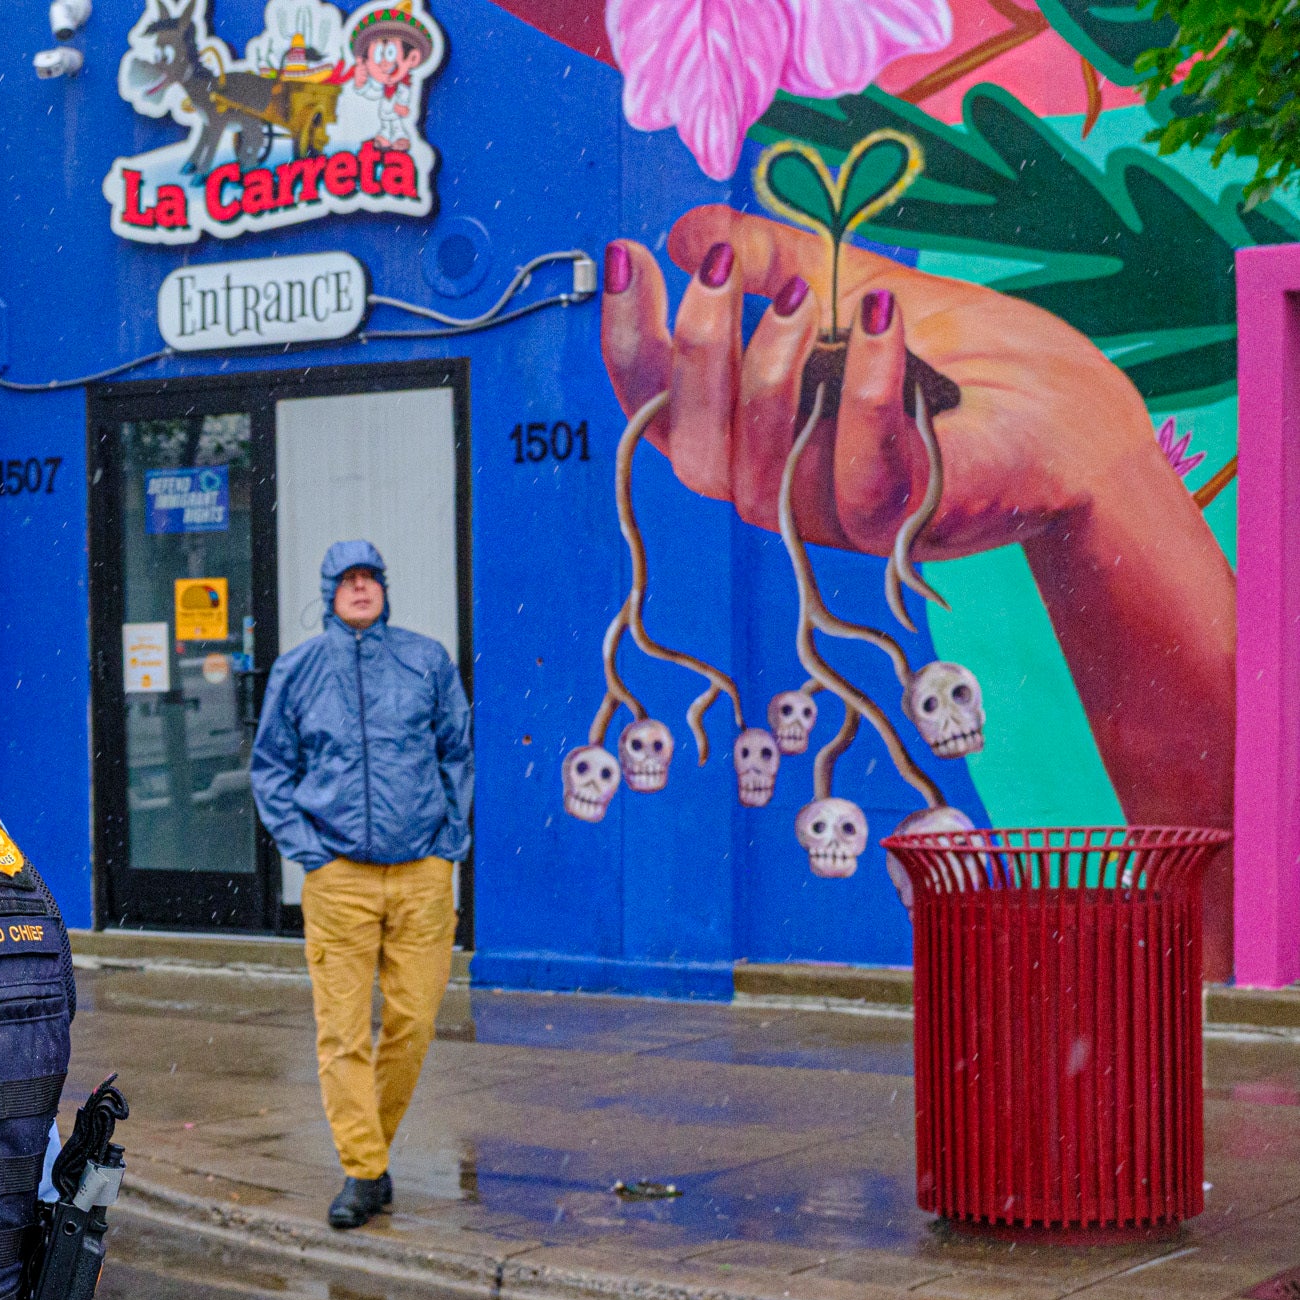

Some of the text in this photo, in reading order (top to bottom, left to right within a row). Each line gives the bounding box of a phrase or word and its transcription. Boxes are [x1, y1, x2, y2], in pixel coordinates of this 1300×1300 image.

[121, 140, 419, 228] La Carreta
[509, 420, 591, 464] 1501
[9, 925, 45, 943] CHIEF
